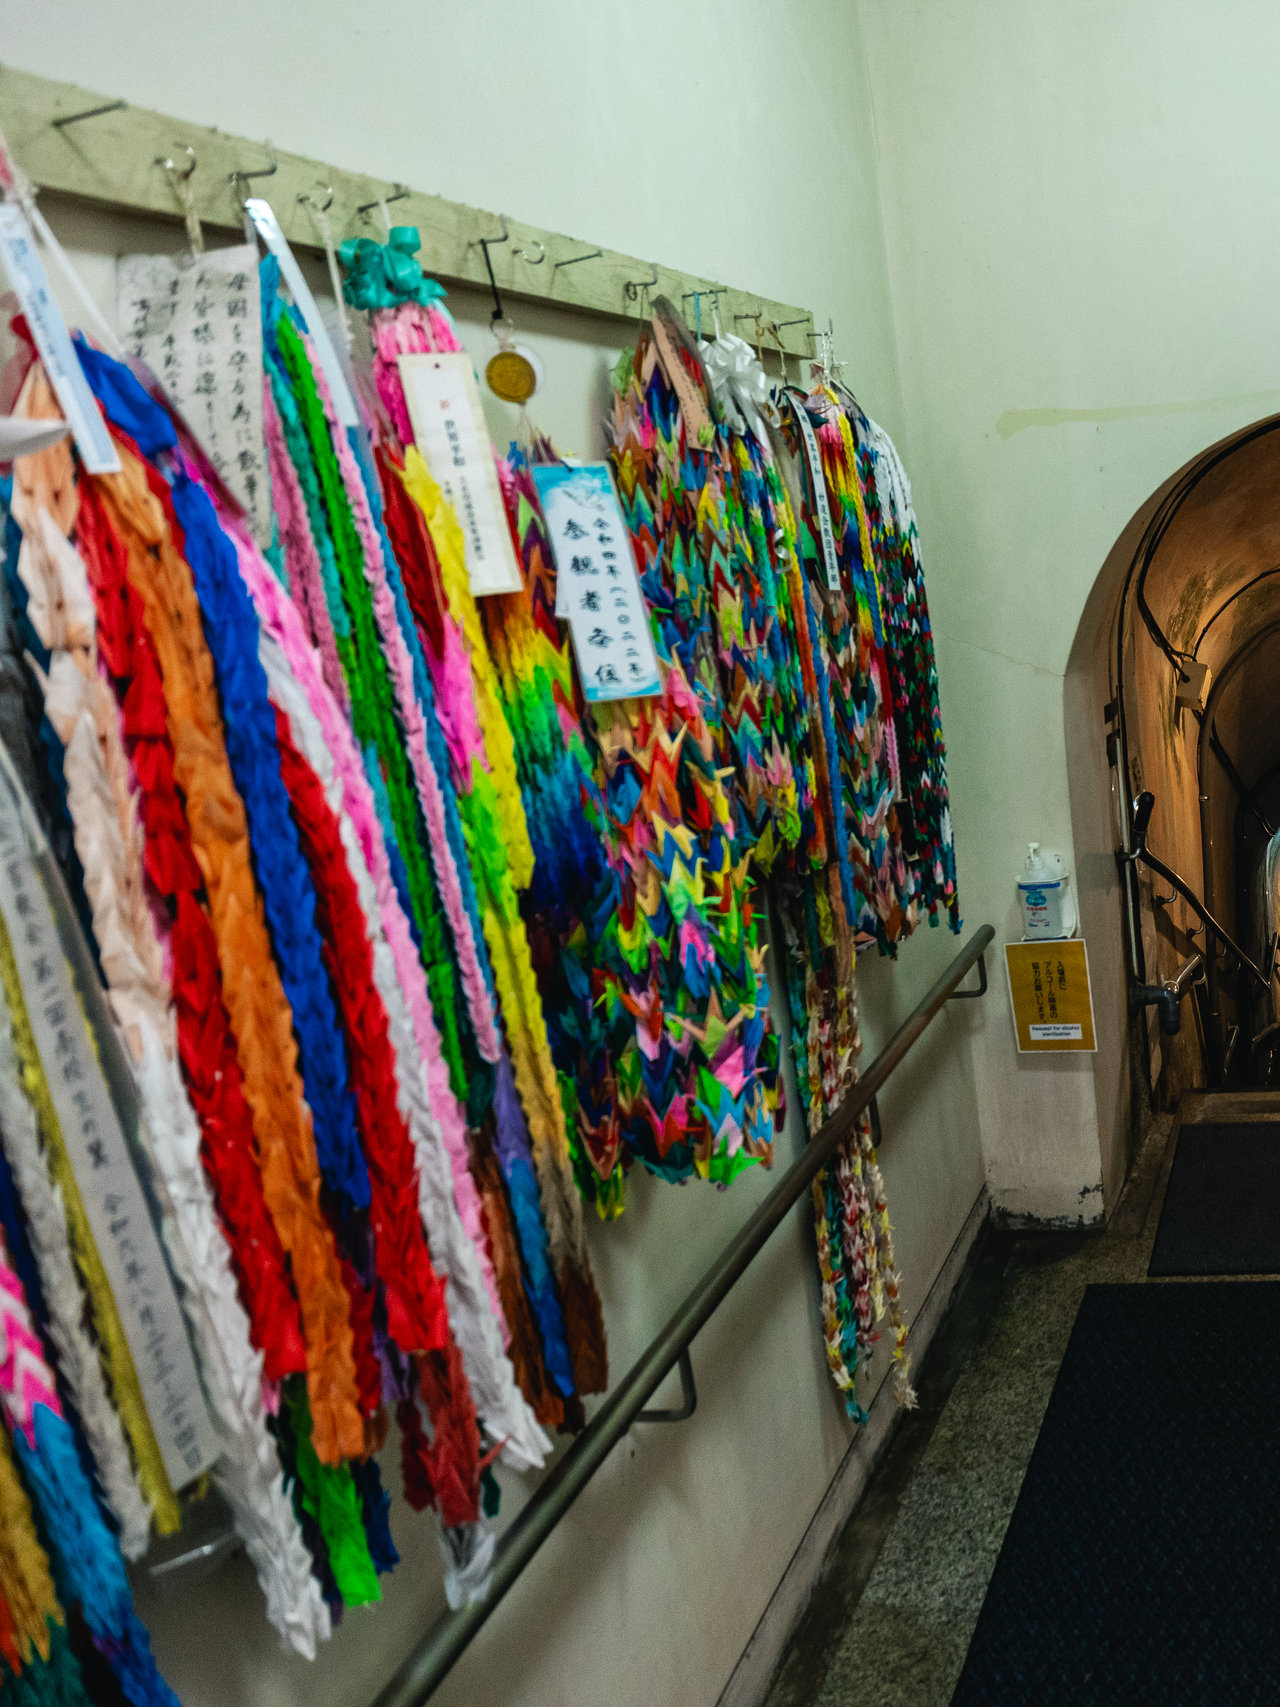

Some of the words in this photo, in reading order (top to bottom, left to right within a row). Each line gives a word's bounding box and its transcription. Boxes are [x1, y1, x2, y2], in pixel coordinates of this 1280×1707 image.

[1044, 961, 1058, 1019] アルコール除菌の
[1057, 960, 1067, 991] 入場前に
